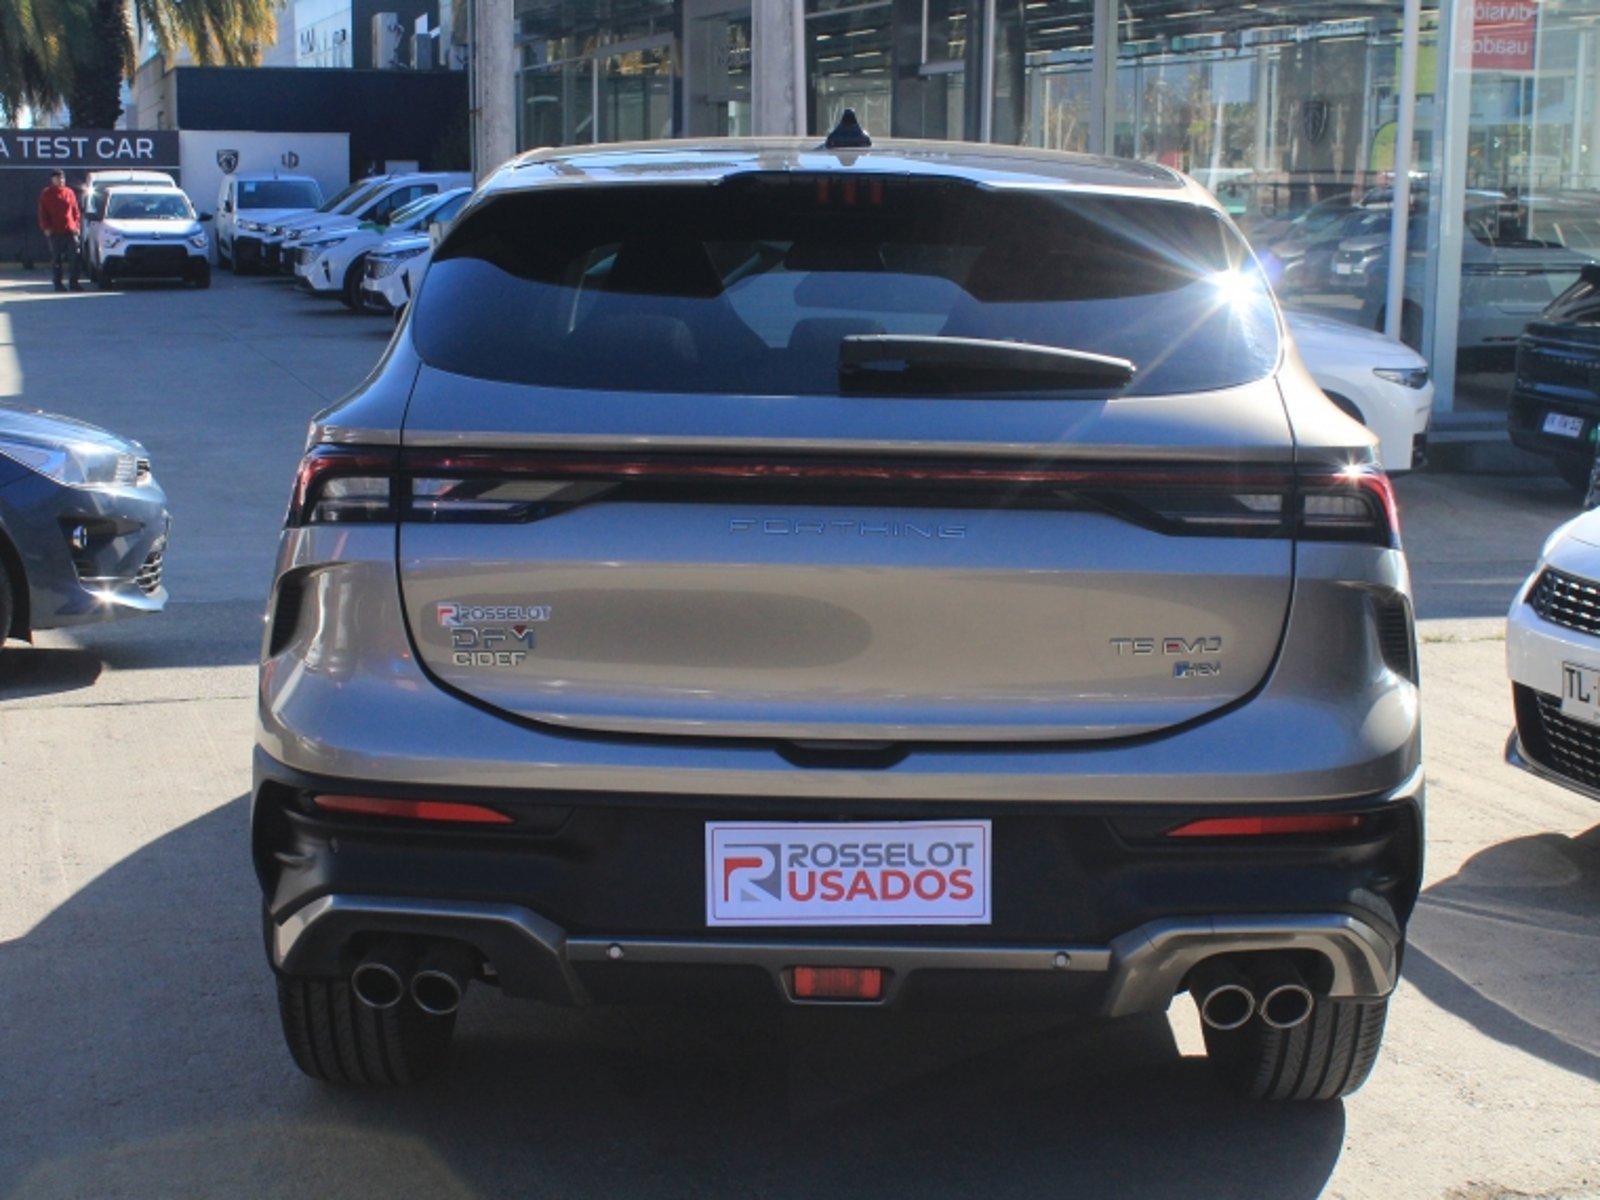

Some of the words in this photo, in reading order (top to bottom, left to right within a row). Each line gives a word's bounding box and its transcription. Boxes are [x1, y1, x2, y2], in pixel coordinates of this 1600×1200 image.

[16, 136, 89, 159] TEST
[96, 137, 154, 159] CAR
[729, 518, 967, 539] FORTHING
[461, 606, 551, 621] ROSSELOT
[1162, 636, 1222, 655] EVO
[453, 651, 526, 667] CIDEF
[787, 842, 974, 868] ROSSELOT
[787, 869, 974, 901] USADOS
